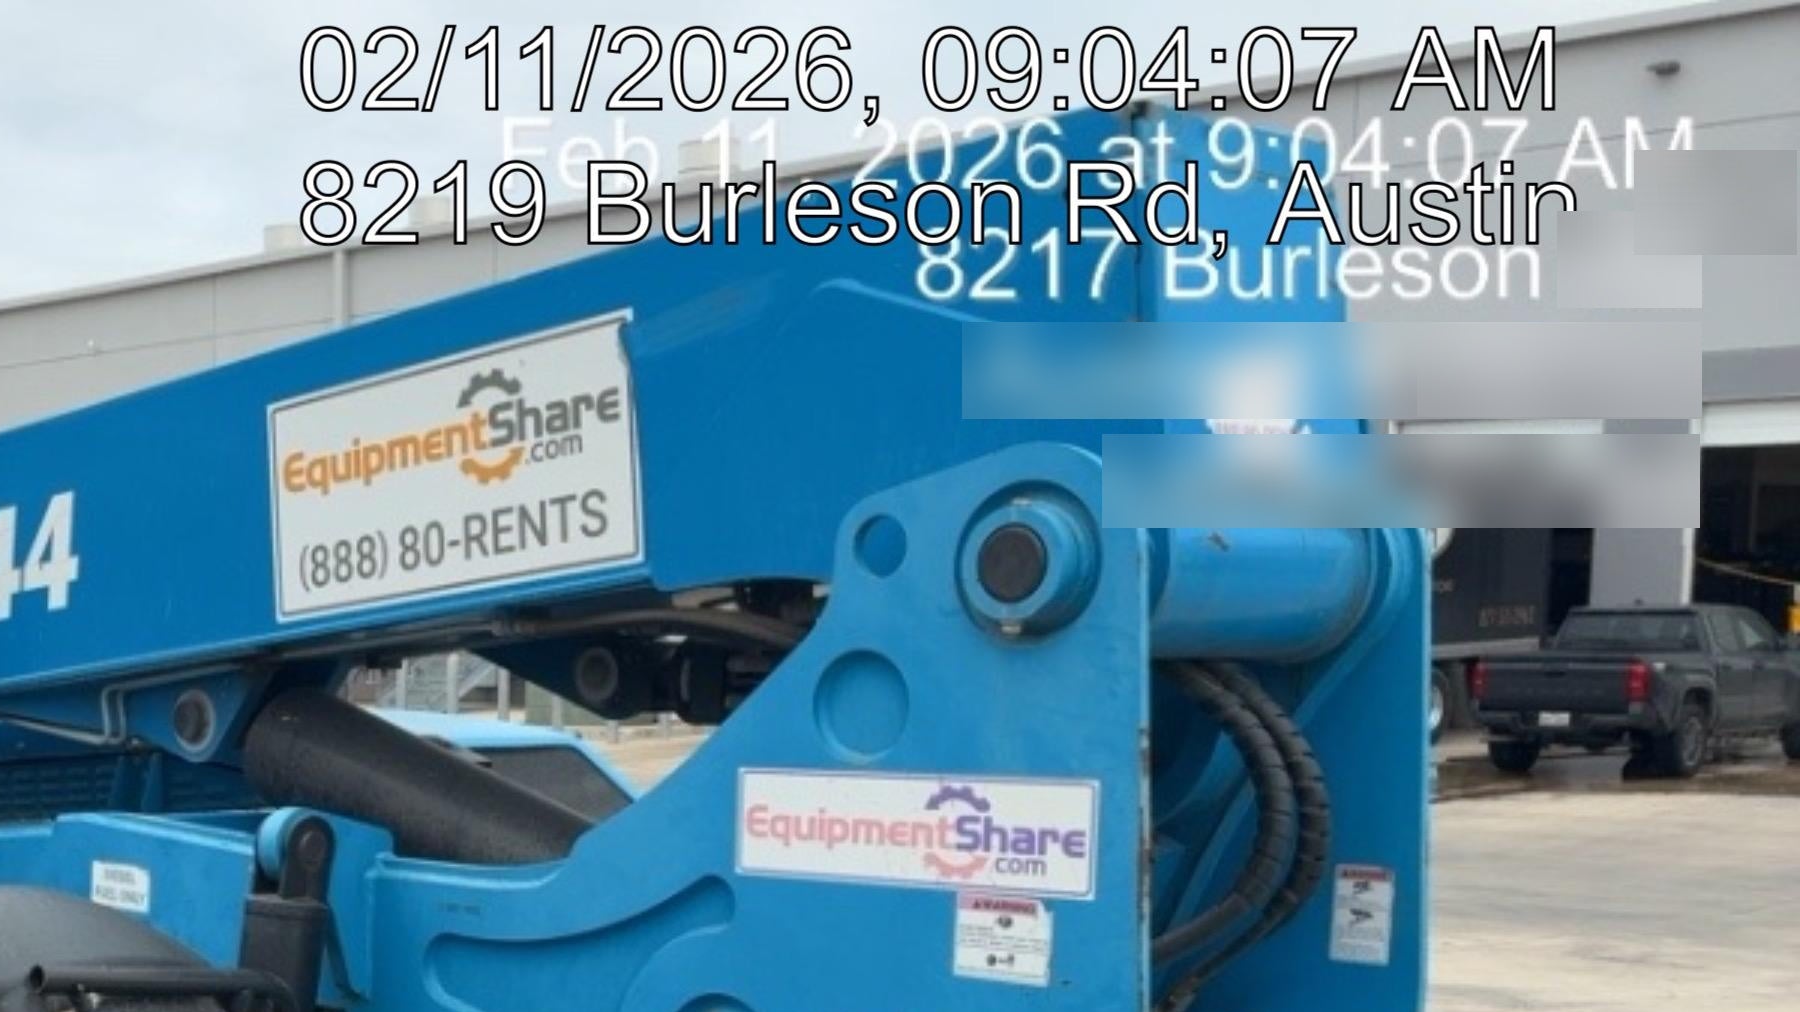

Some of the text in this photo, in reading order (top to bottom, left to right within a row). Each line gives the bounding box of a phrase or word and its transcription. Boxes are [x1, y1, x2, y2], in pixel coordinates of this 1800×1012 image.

[281, 386, 621, 494] EquipmentShare
[299, 488, 609, 592] (888) 80-RENTS
[743, 803, 1087, 859] EquipmentShare
